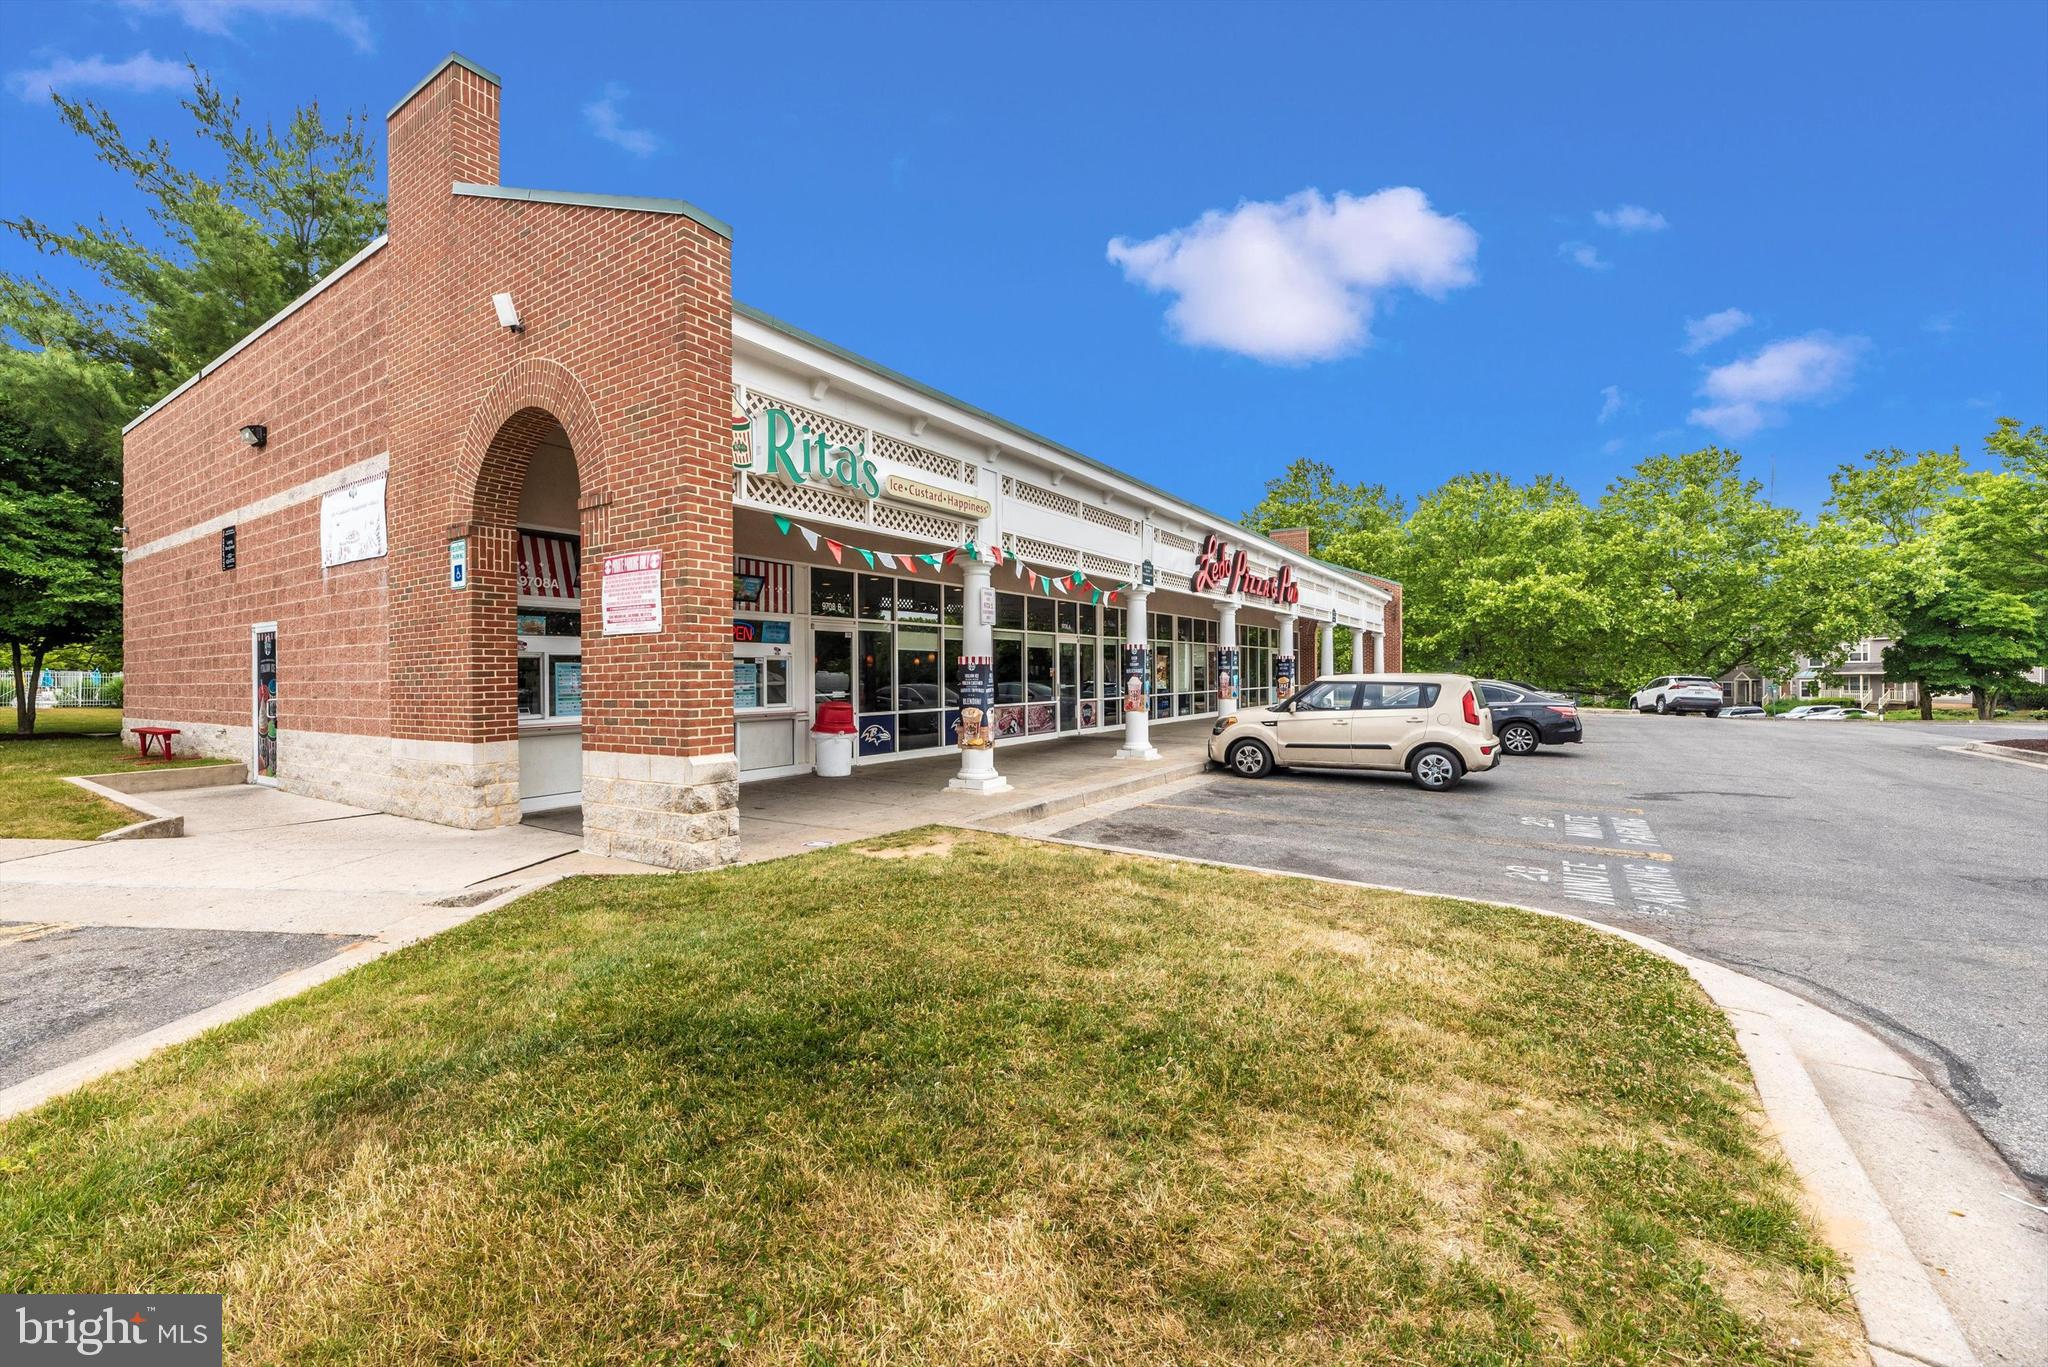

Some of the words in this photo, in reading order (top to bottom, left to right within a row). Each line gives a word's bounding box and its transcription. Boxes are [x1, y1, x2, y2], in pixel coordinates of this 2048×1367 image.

[766, 408, 880, 499] Rita's
[889, 480, 904, 493] Ice
[908, 484, 943, 504] Custard
[947, 493, 987, 514] Happiness
[1194, 533, 1231, 592] Ledo
[519, 576, 559, 589] 9708A
[1564, 814, 1604, 840] MINUTE
[1610, 816, 1662, 847] PARKING
[1562, 860, 1616, 905] MINUTE
